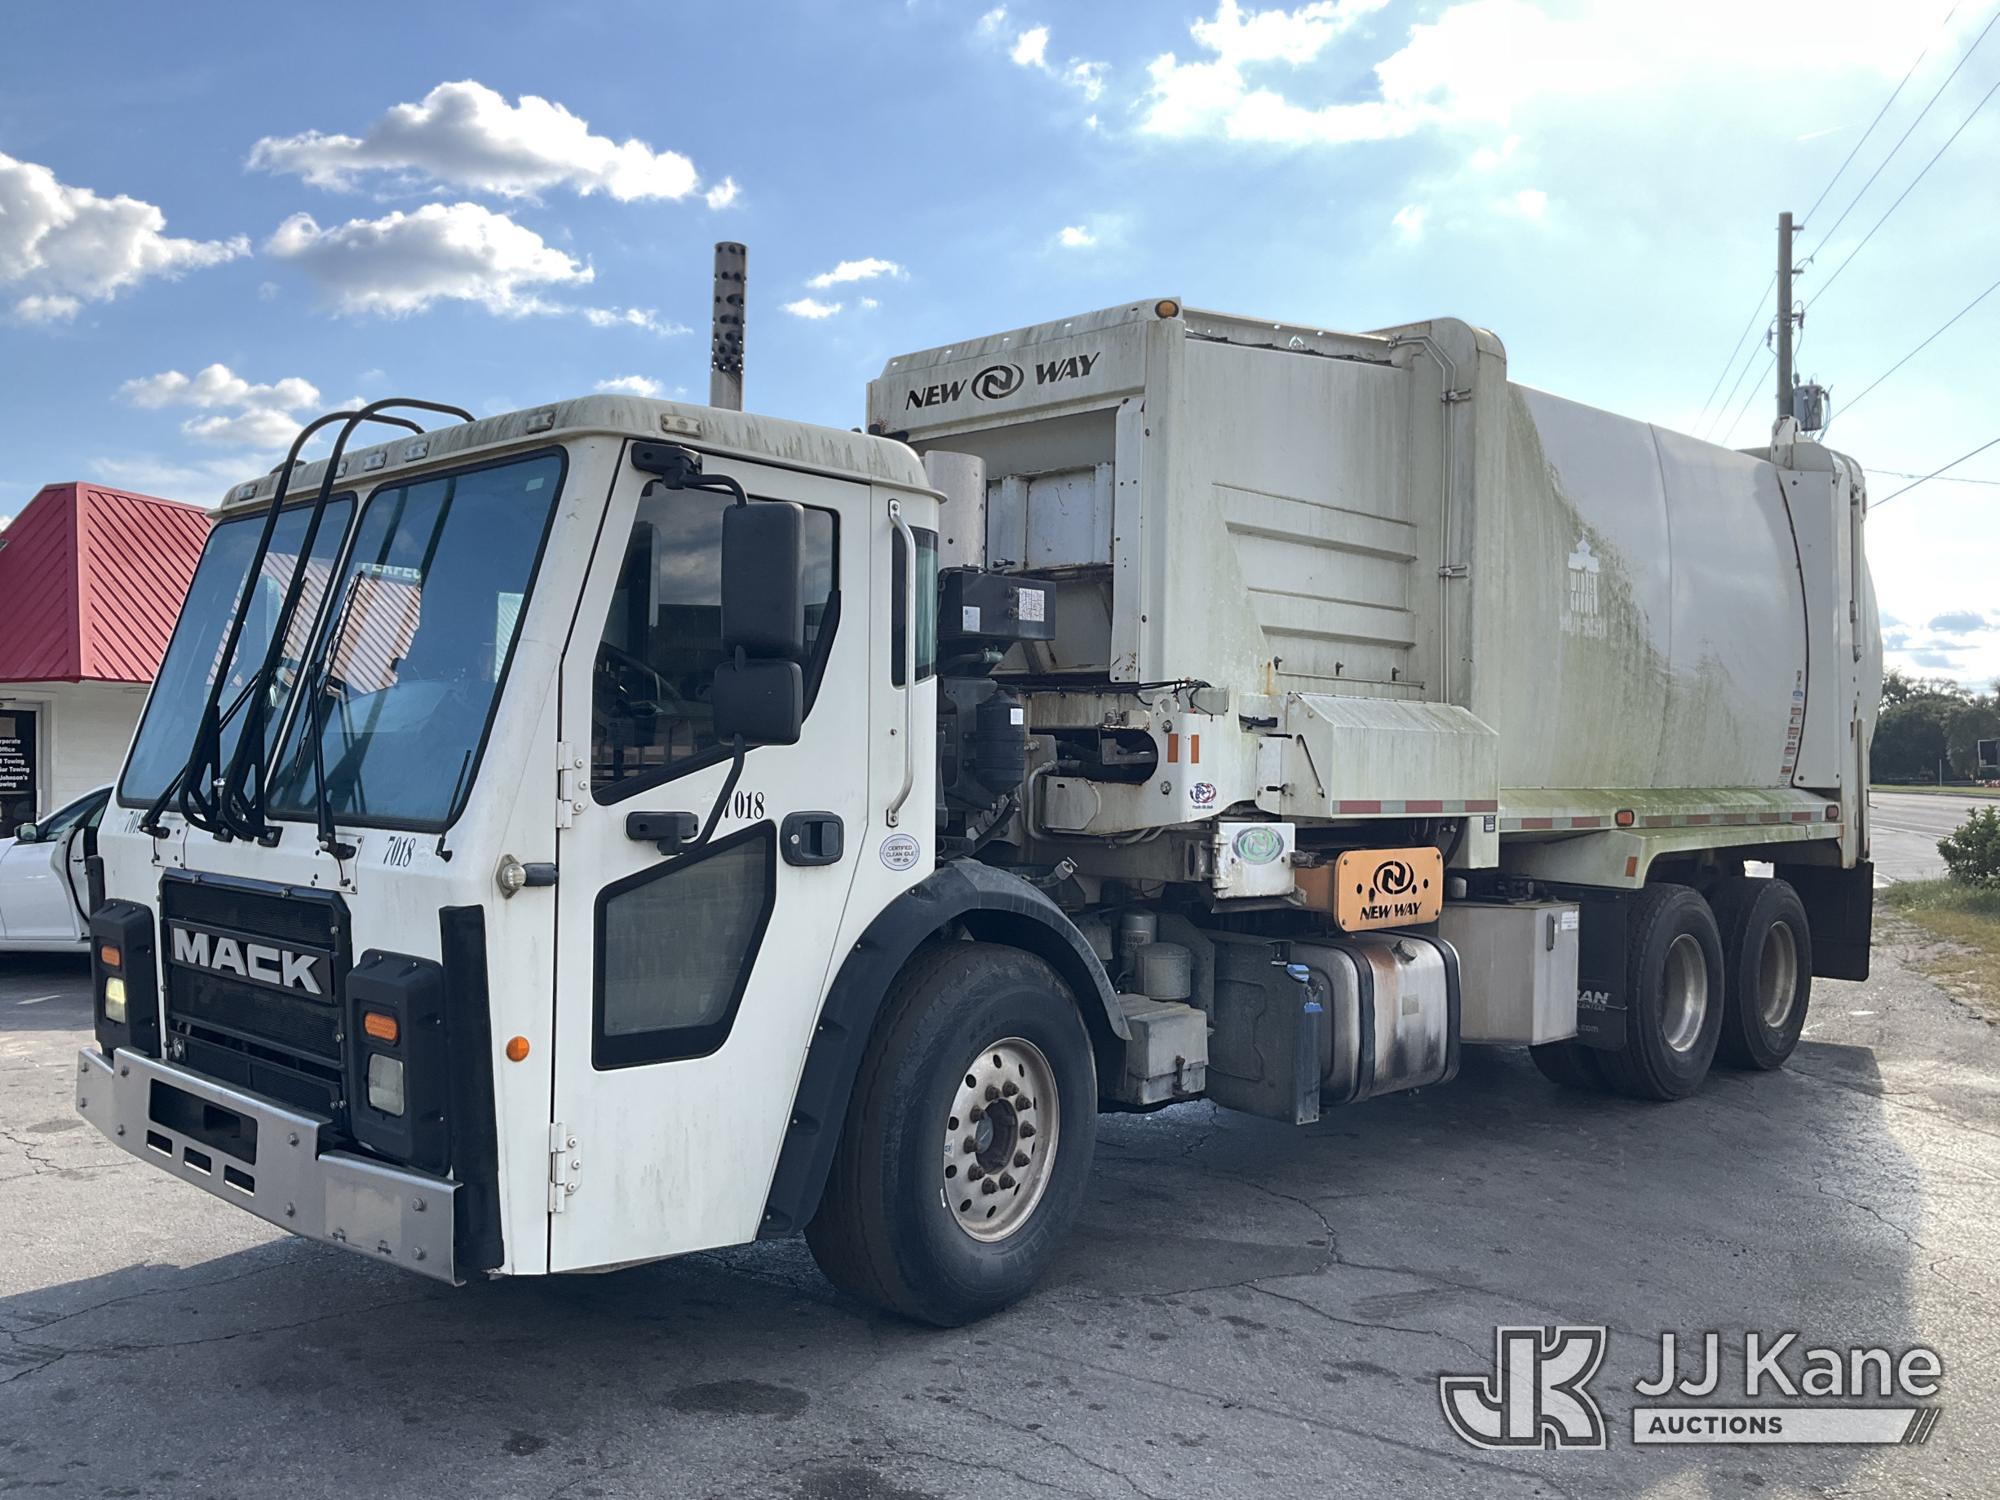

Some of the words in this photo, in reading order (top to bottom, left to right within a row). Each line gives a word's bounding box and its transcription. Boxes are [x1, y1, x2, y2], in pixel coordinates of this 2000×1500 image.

[905, 379, 968, 410] NEW
[1035, 351, 1101, 385] WAY
[383, 836, 417, 868] 7018
[1360, 904, 1393, 920] NEW
[1394, 901, 1422, 917] WAY
[173, 927, 323, 995] MACK
